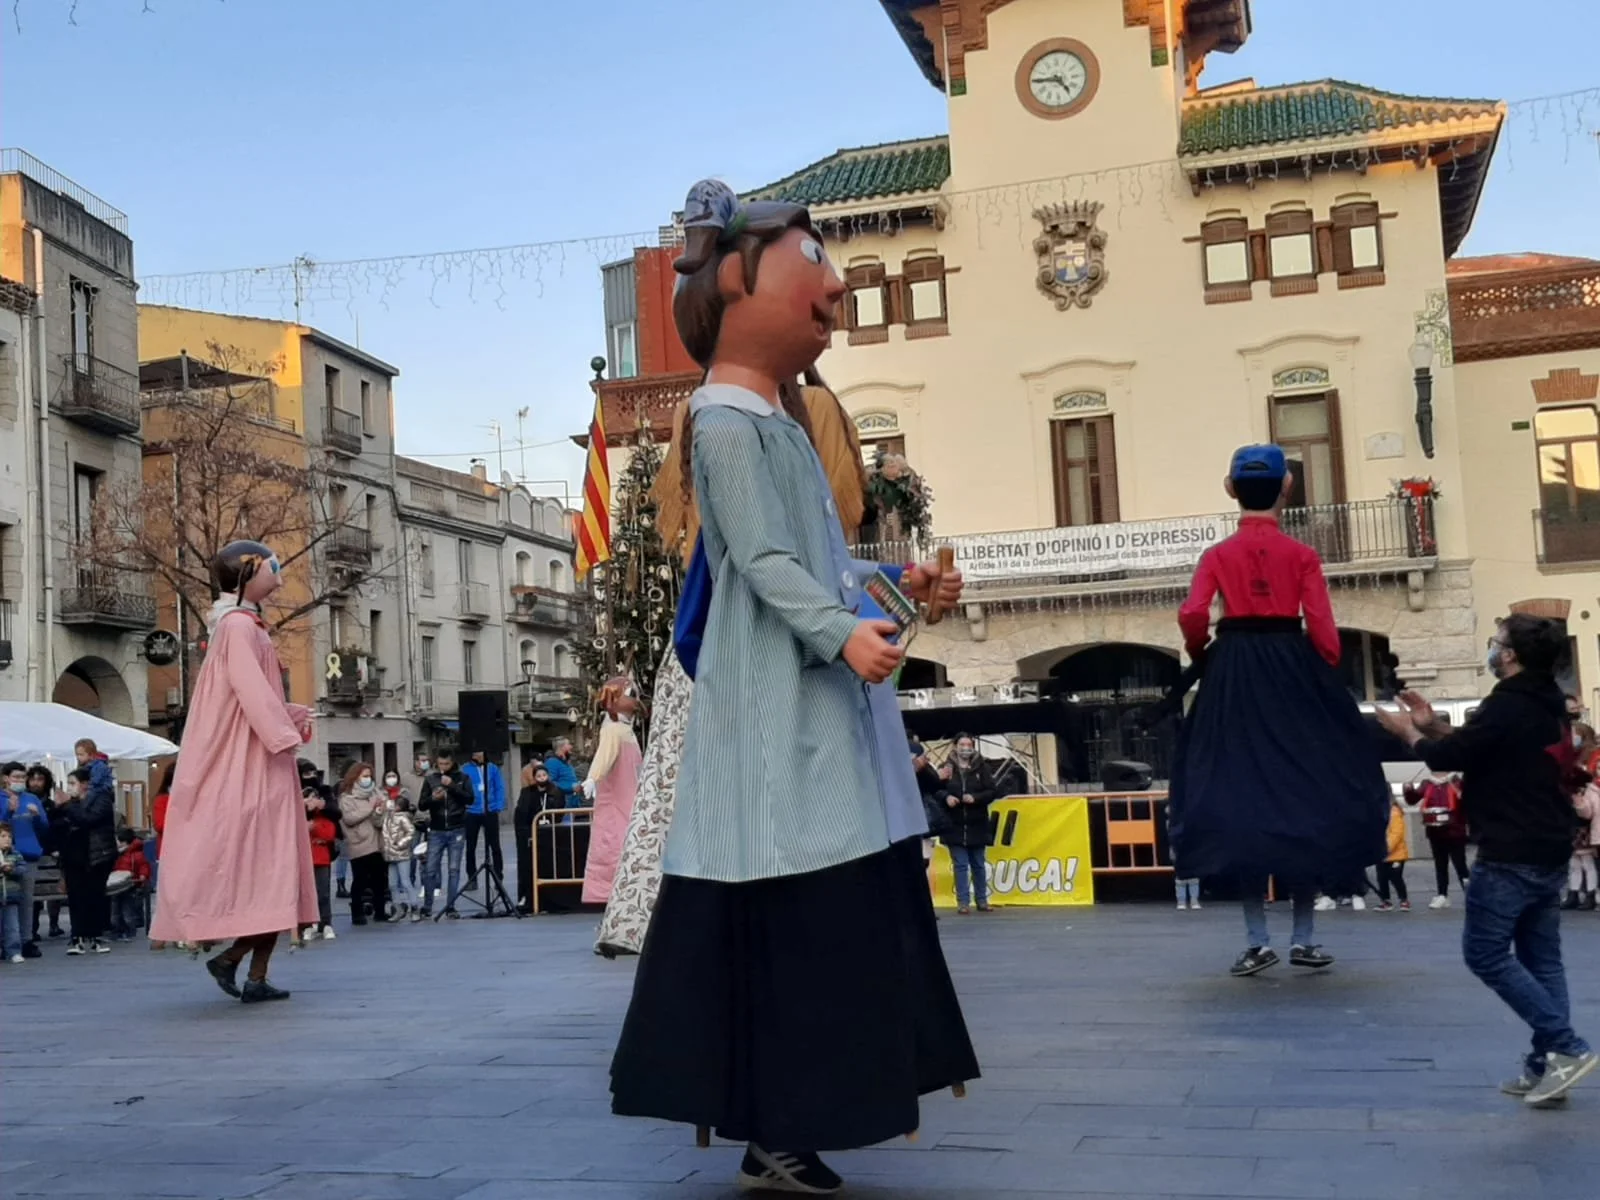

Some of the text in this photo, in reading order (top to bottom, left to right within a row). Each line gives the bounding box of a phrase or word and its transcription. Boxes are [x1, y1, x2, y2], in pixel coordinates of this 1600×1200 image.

[956, 524, 1215, 560] LLIBERTAT D'OPINIÓ I D'EXPRESSIÓ
